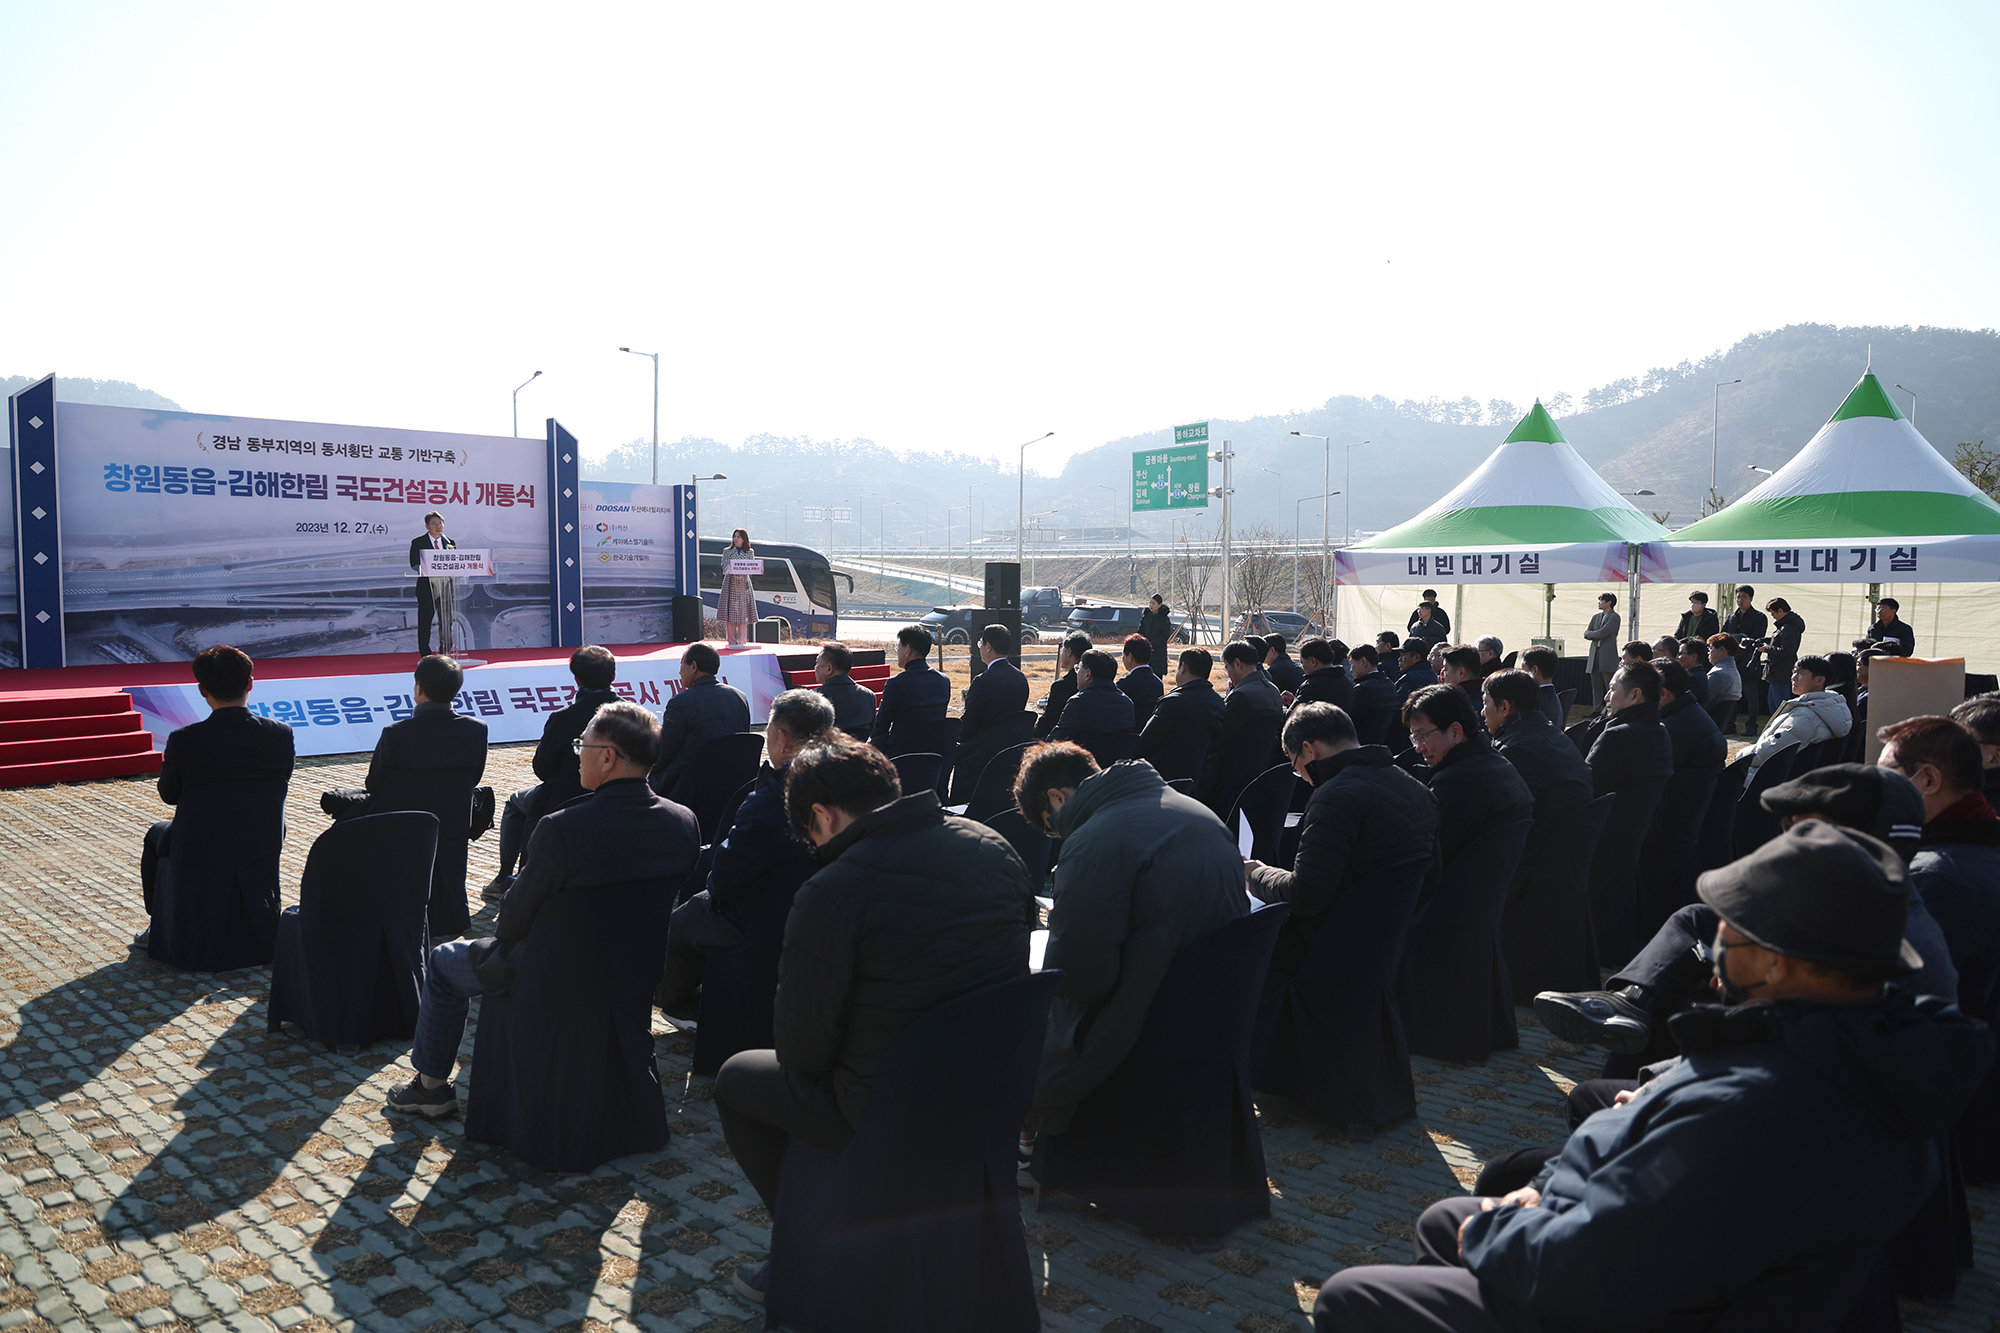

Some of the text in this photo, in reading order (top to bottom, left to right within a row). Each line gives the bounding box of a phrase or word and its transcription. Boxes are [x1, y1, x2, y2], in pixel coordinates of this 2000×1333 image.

[1176, 427, 1207, 440] 봉하교차로
[212, 435, 456, 464] 경남 동부지역의 동서횡단 교통 기반구축
[1145, 453, 1168, 465] 금봉마을
[1136, 470, 1147, 479] 부산
[104, 463, 535, 508] 창원동읍-김해한림 국도건설공사 개통식
[1188, 482, 1200, 493] 창원
[296, 522, 389, 535] 2023년 12. 27.(수)
[1408, 553, 1540, 576] 내빈대기실
[1738, 547, 1917, 573] 내빈대기실
